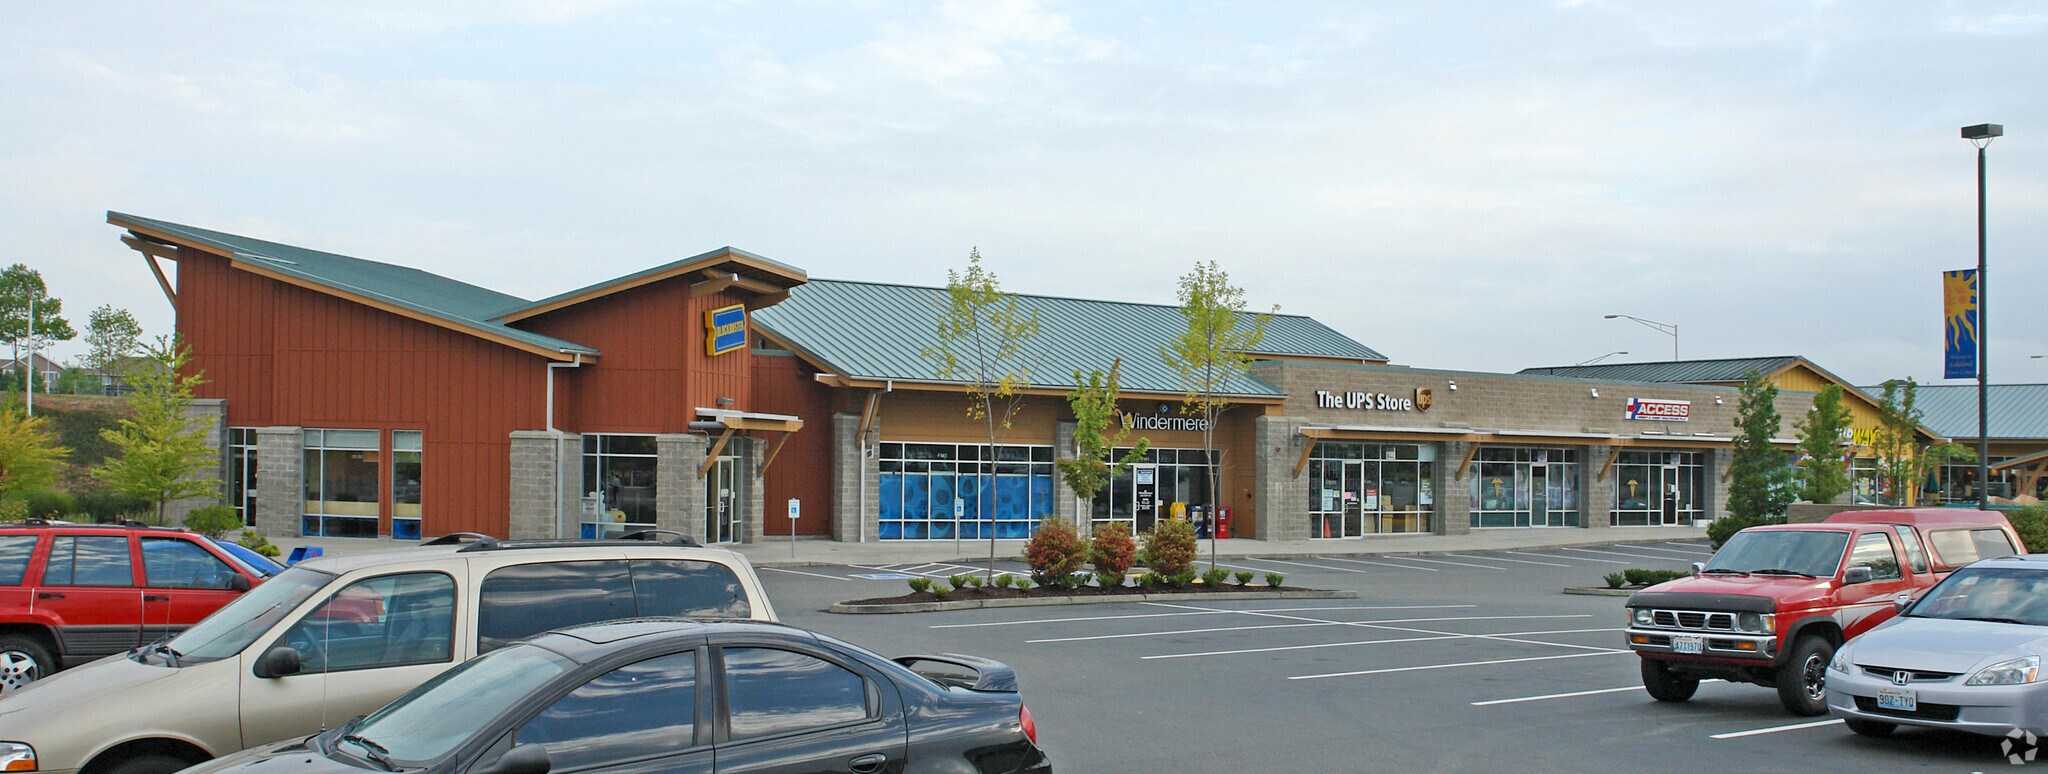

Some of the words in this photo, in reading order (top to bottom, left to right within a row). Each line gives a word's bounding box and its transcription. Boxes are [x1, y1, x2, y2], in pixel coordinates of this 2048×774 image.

[1317, 390, 1343, 409] The
[1346, 391, 1374, 410] UPS
[1377, 392, 1411, 411] Store
[1418, 394, 1431, 408] ups
[1636, 403, 1689, 416] ACCESS
[1119, 411, 1210, 431] Windermere
